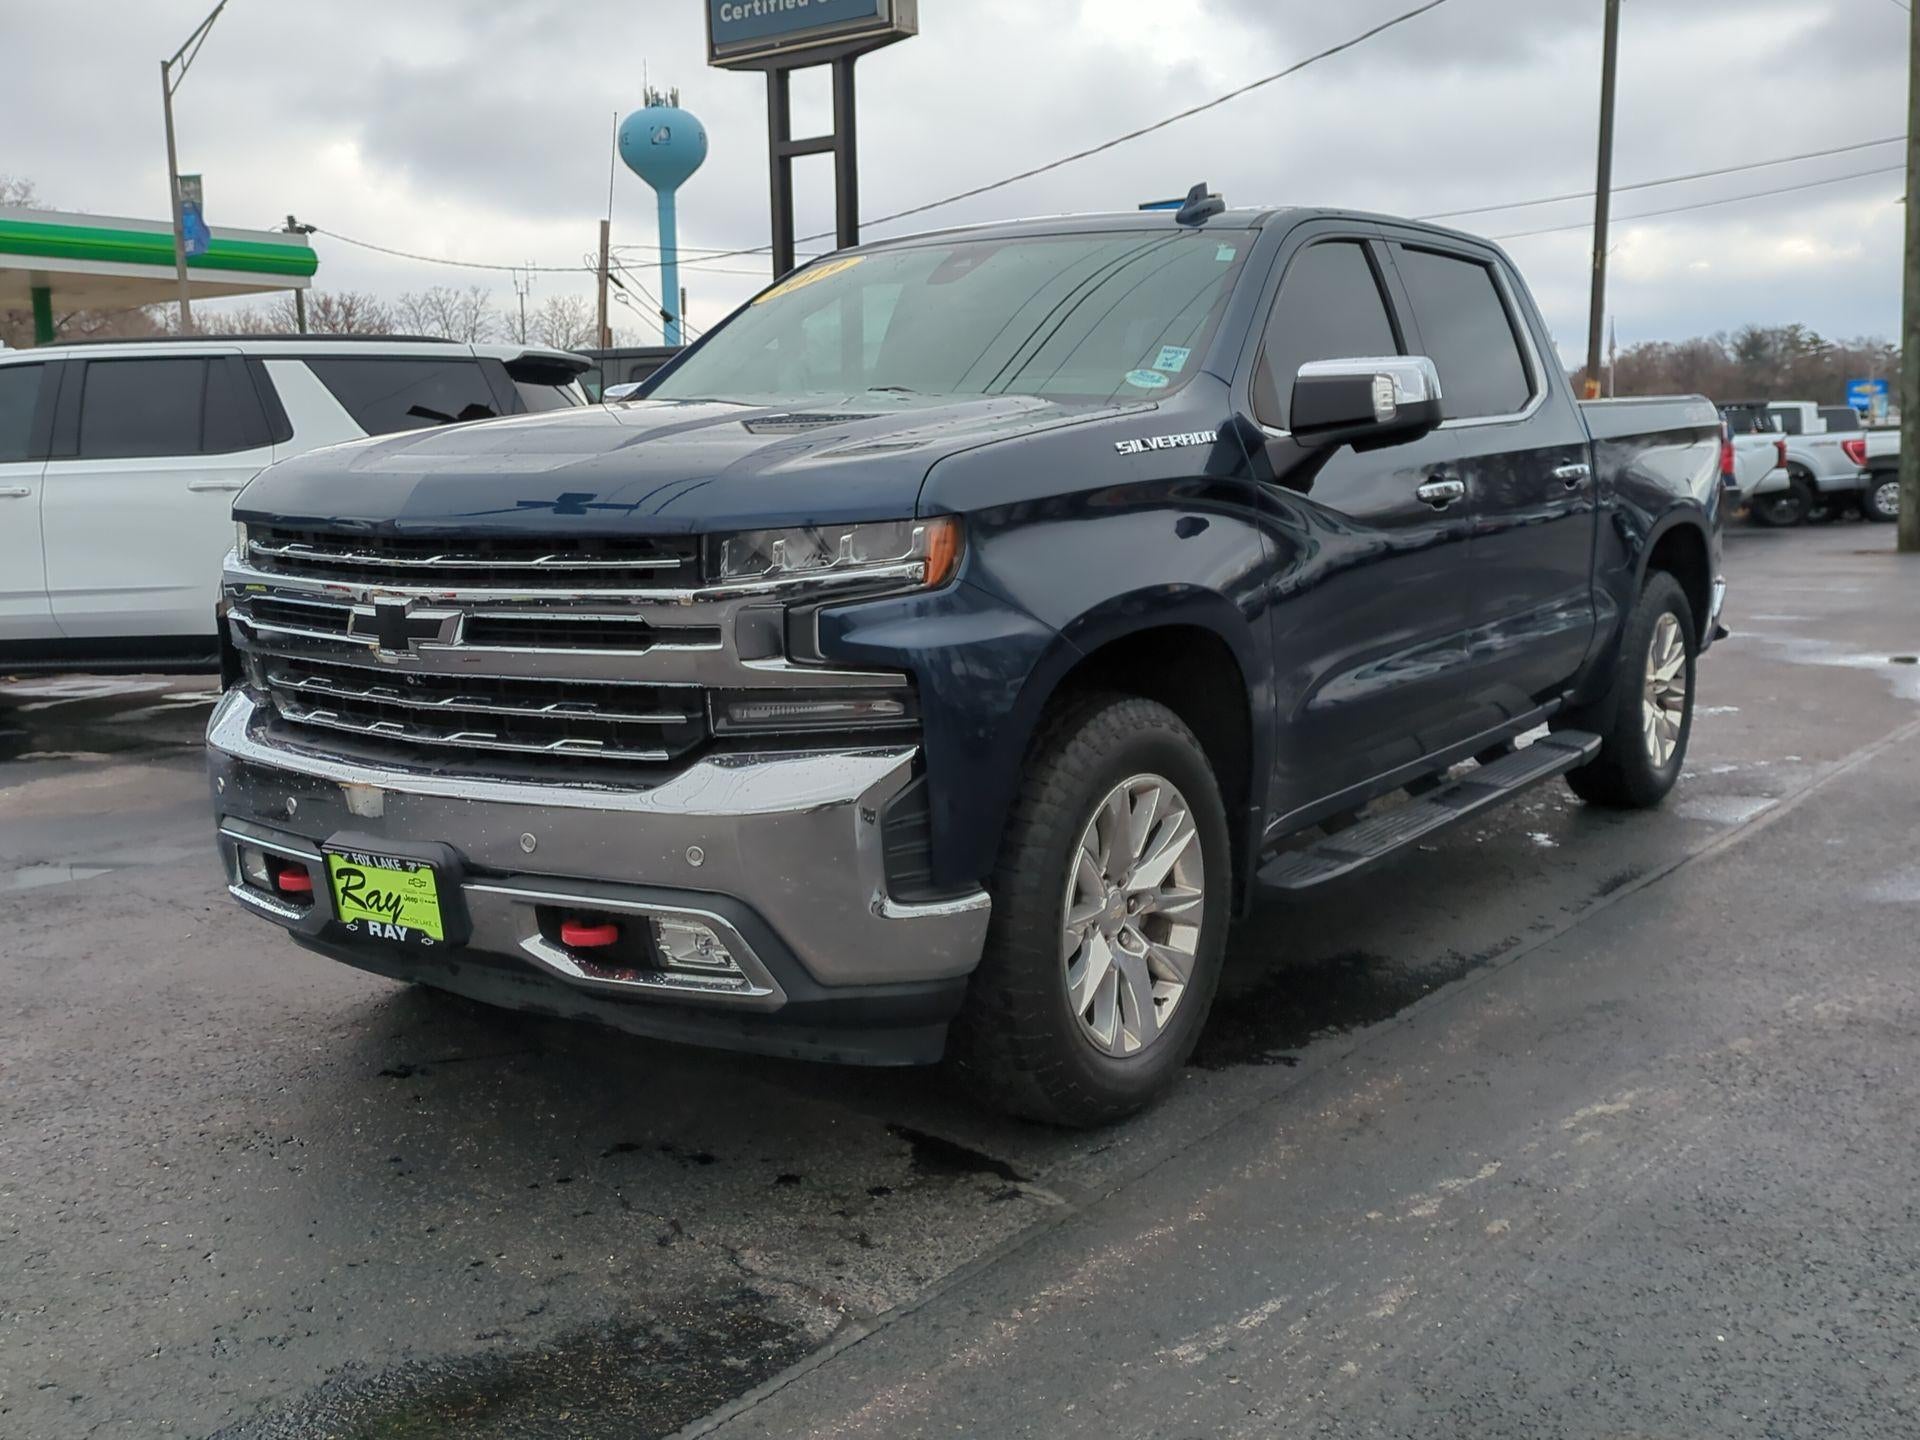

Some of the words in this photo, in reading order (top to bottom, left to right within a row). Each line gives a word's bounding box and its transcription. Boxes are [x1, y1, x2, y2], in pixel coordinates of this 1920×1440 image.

[1115, 430, 1218, 455] SILVERADO
[352, 852, 374, 868] FOX
[374, 856, 403, 871] LAKE
[336, 868, 405, 924] Ray
[368, 920, 408, 942] RAY
